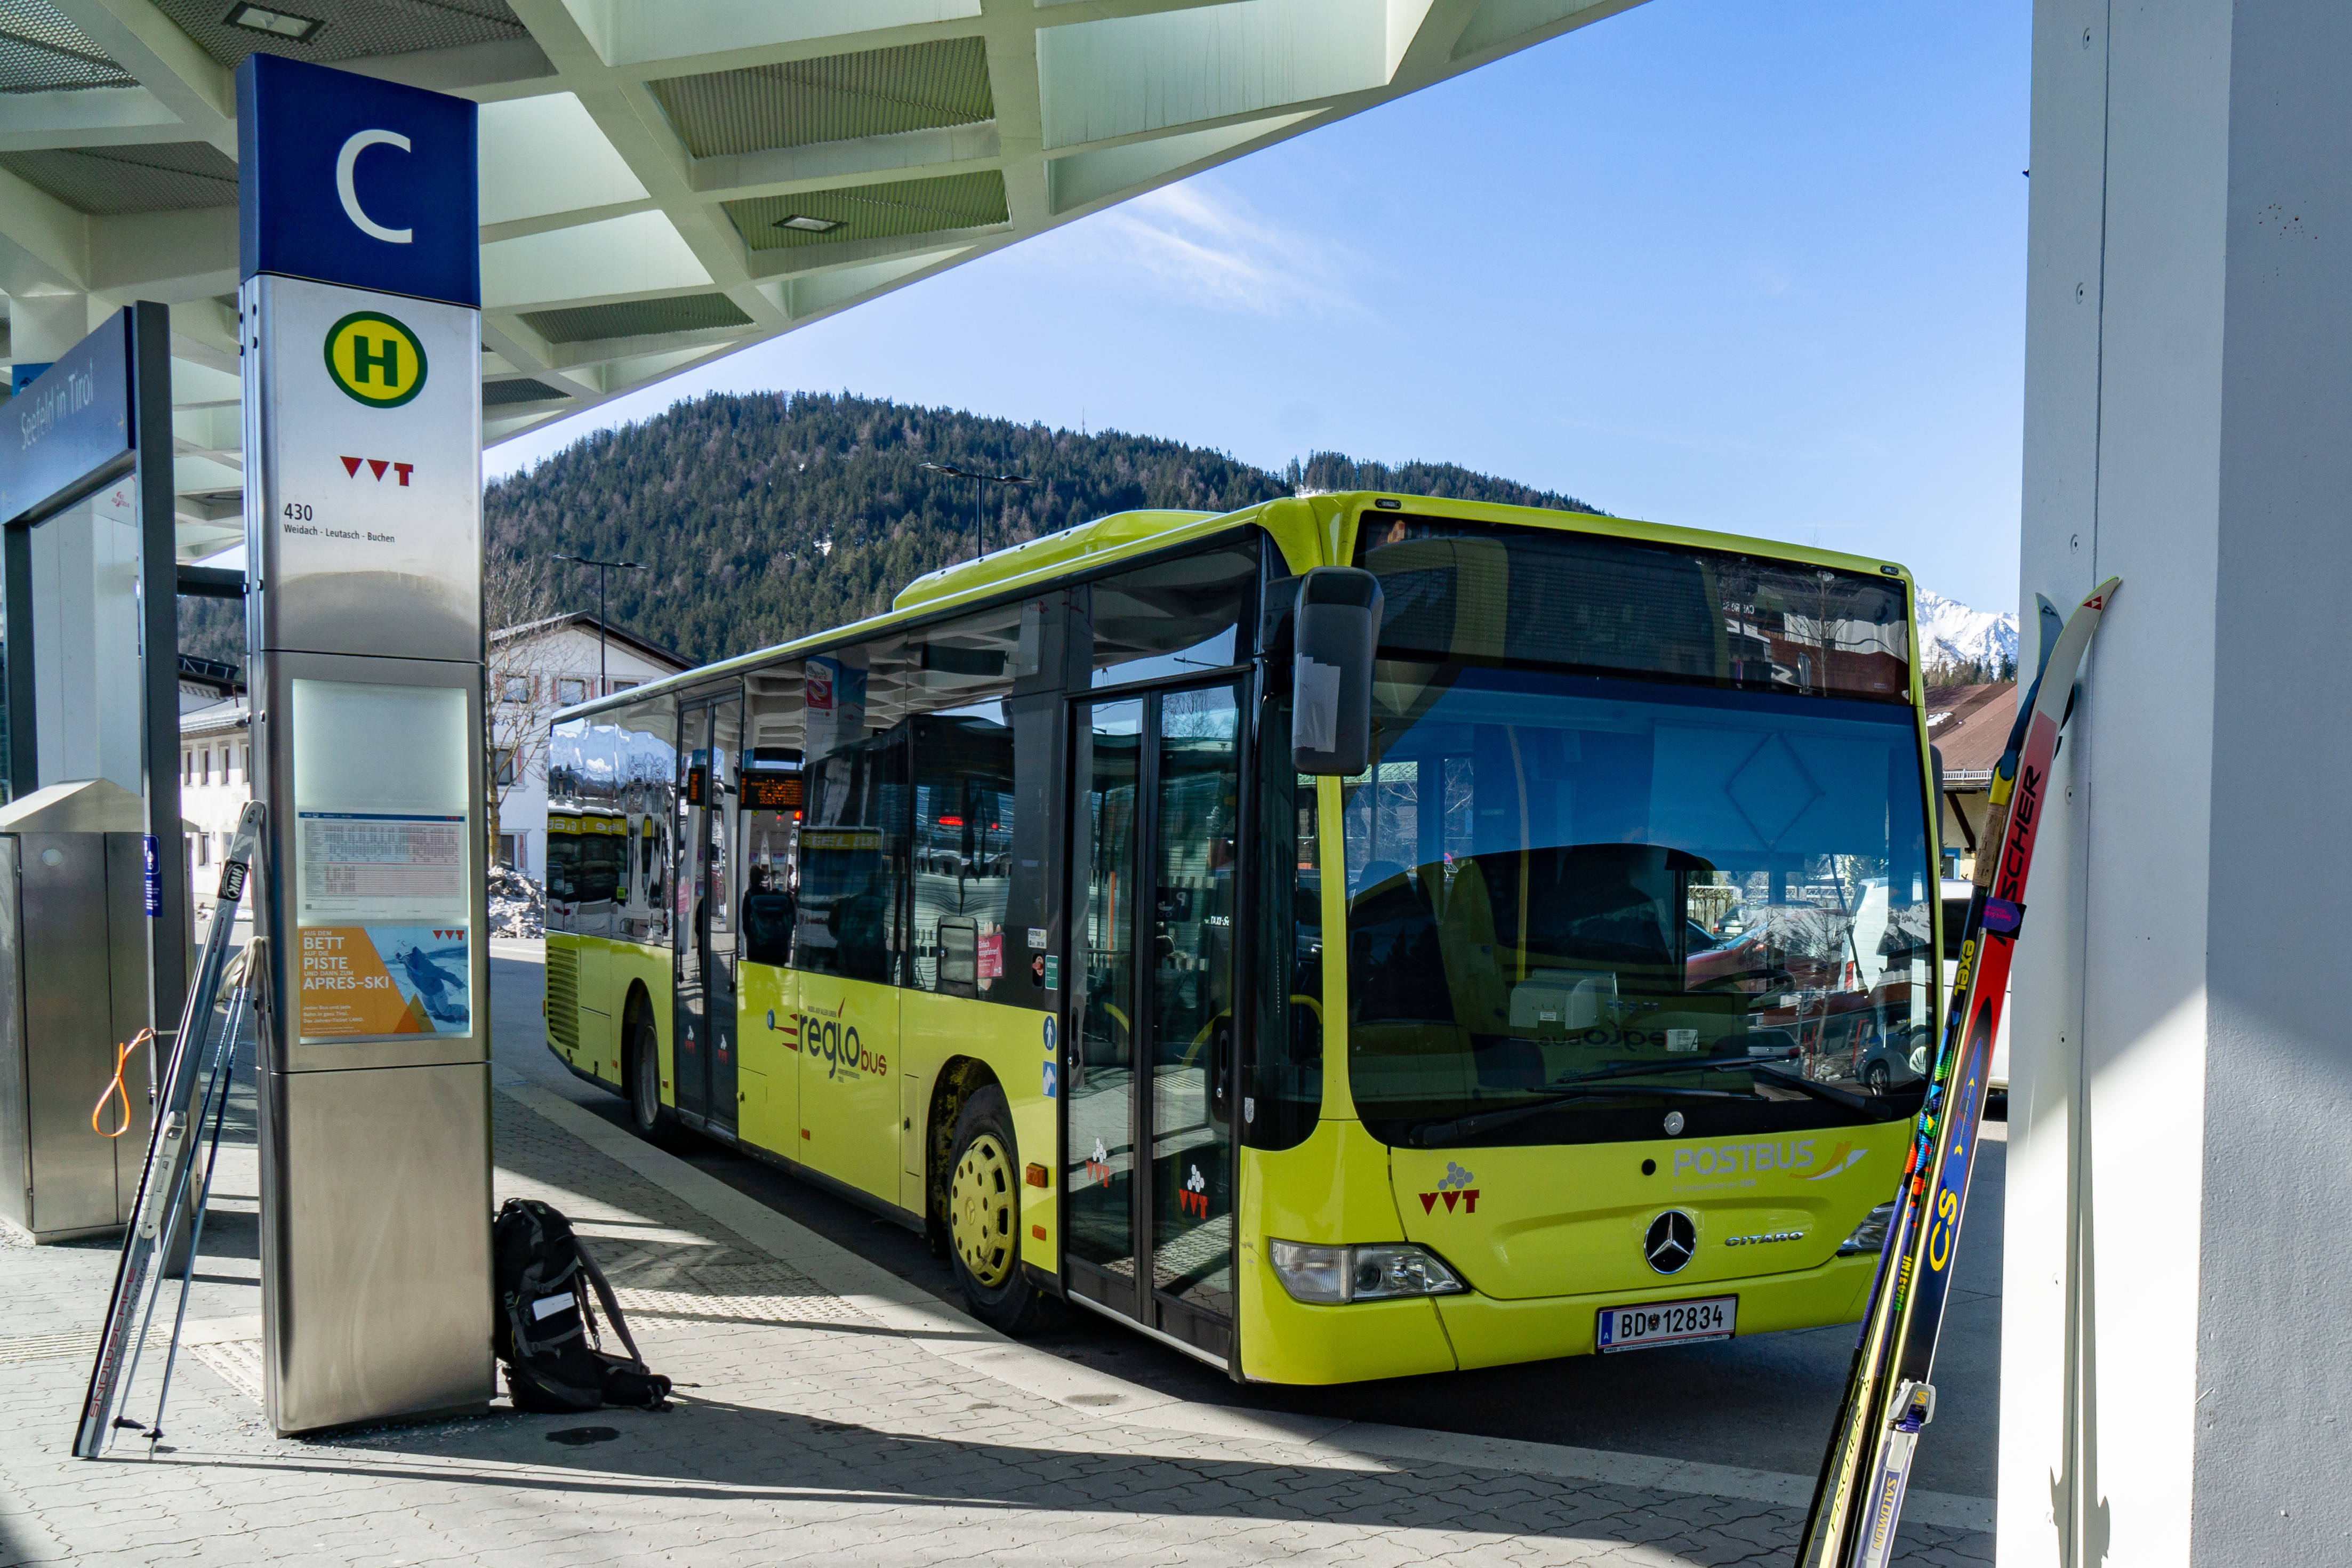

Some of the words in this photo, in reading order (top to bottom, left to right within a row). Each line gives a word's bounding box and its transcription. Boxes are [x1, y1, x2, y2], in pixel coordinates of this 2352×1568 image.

[335, 128, 413, 244] C
[354, 335, 398, 388] H
[21, 387, 53, 450] Seefeld
[57, 383, 66, 420] in
[68, 357, 93, 414] Tirol
[340, 456, 414, 487] VVT
[284, 503, 312, 521] 430
[284, 524, 318, 535] Weidach
[326, 528, 359, 540] Leutasch
[368, 532, 395, 543] Buchen
[2001, 765, 2041, 902] SCHER
[228, 868, 243, 895] HWK
[303, 937, 344, 950] BETT
[433, 930, 464, 940] VVT
[303, 957, 348, 970] PISTE
[1954, 940, 1975, 996] exel
[303, 976, 389, 990] APRES-SKI
[1673, 1139, 1816, 1177] POSTBUS
[1419, 1189, 1480, 1216] VVT
[1724, 1231, 1804, 1246] CITARO
[1893, 1255, 1912, 1311] INTEGRA
[1621, 1313, 1646, 1338] BD
[1663, 1305, 1723, 1333] 12834
[90, 1268, 136, 1418] SNOWSCAPE
[1831, 1405, 1863, 1533] FISCHER
[1872, 1477, 1897, 1551] SALOMON
